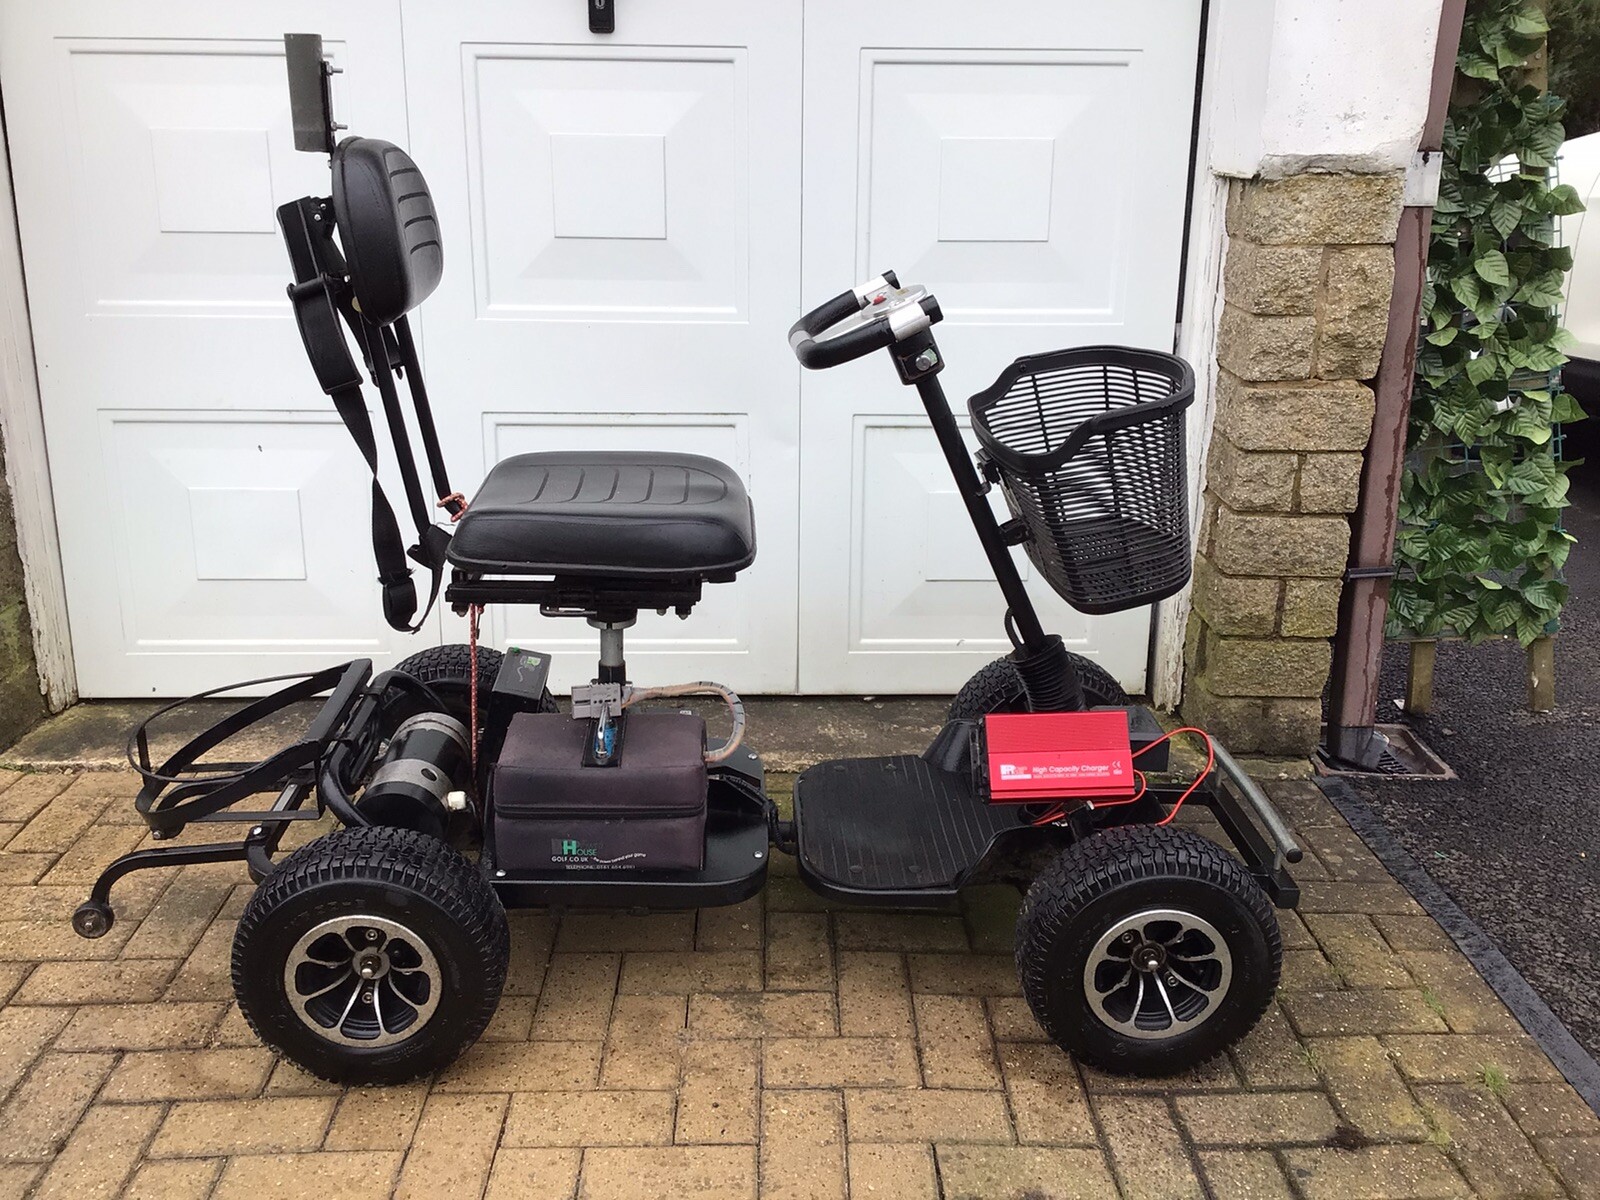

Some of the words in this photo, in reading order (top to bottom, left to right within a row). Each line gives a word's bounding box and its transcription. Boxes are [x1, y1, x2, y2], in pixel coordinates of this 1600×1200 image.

[1032, 766, 1047, 774] High
[1048, 765, 1080, 773] Capacity
[1081, 764, 1109, 773] Charger
